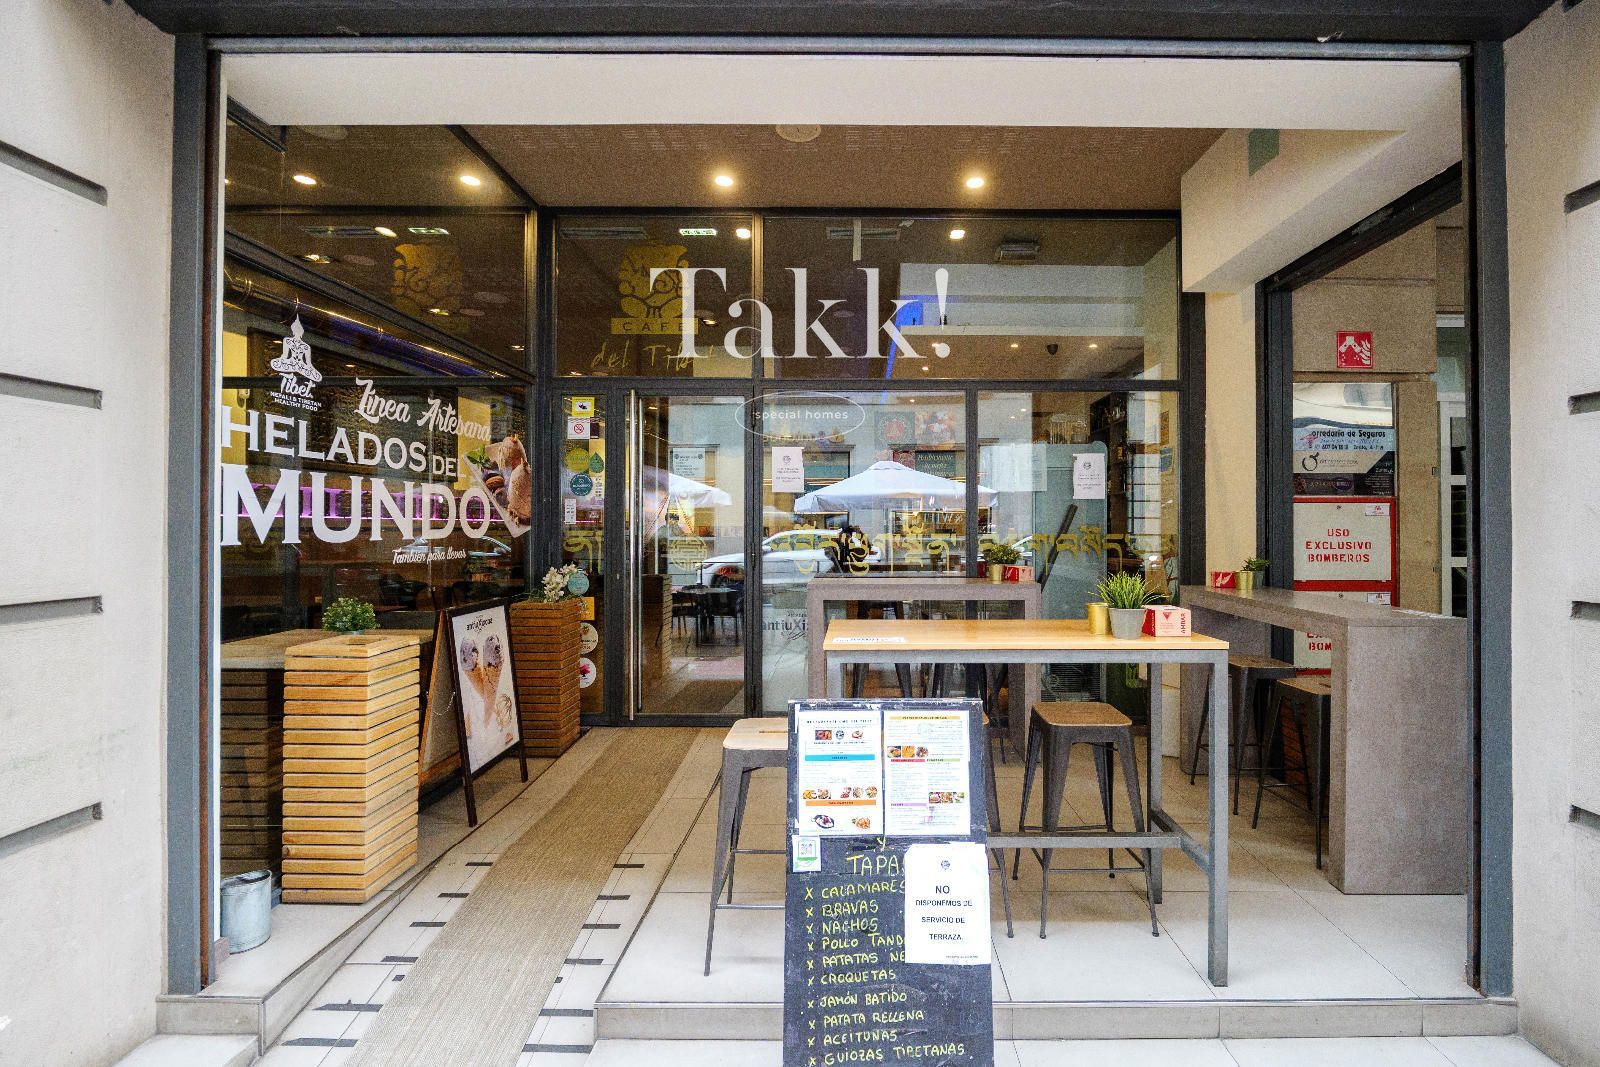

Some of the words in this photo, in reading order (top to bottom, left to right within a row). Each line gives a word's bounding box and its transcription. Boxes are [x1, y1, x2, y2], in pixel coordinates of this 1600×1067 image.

[642, 340, 715, 372] Tibt
[279, 372, 316, 399] Tibet
[301, 403, 318, 412] FOOD
[220, 405, 427, 472] HELADOS
[432, 454, 467, 478] DEL
[220, 462, 491, 546] MUNDO
[1327, 528, 1350, 537] USO
[1305, 541, 1372, 550] EXCLUSIVO
[1308, 553, 1371, 563] BOMBEROS
[935, 885, 951, 894] NO
[822, 899, 879, 917] BRAVAS
[915, 899, 962, 907] DISPONEMOS
[822, 917, 879, 935] NACHOS
[921, 916, 954, 924] SERVICIO
[822, 936, 859, 950] POLLO
[868, 932, 905, 948] TAND
[822, 952, 879, 968] PATATAS
[821, 969, 897, 985] CROQUETAS
[820, 990, 858, 1008] JAMÓN
[823, 1013, 866, 1028] PATATA
[872, 1010, 925, 1024] RELLENA
[823, 1029, 898, 1047] ACEITUNAS
